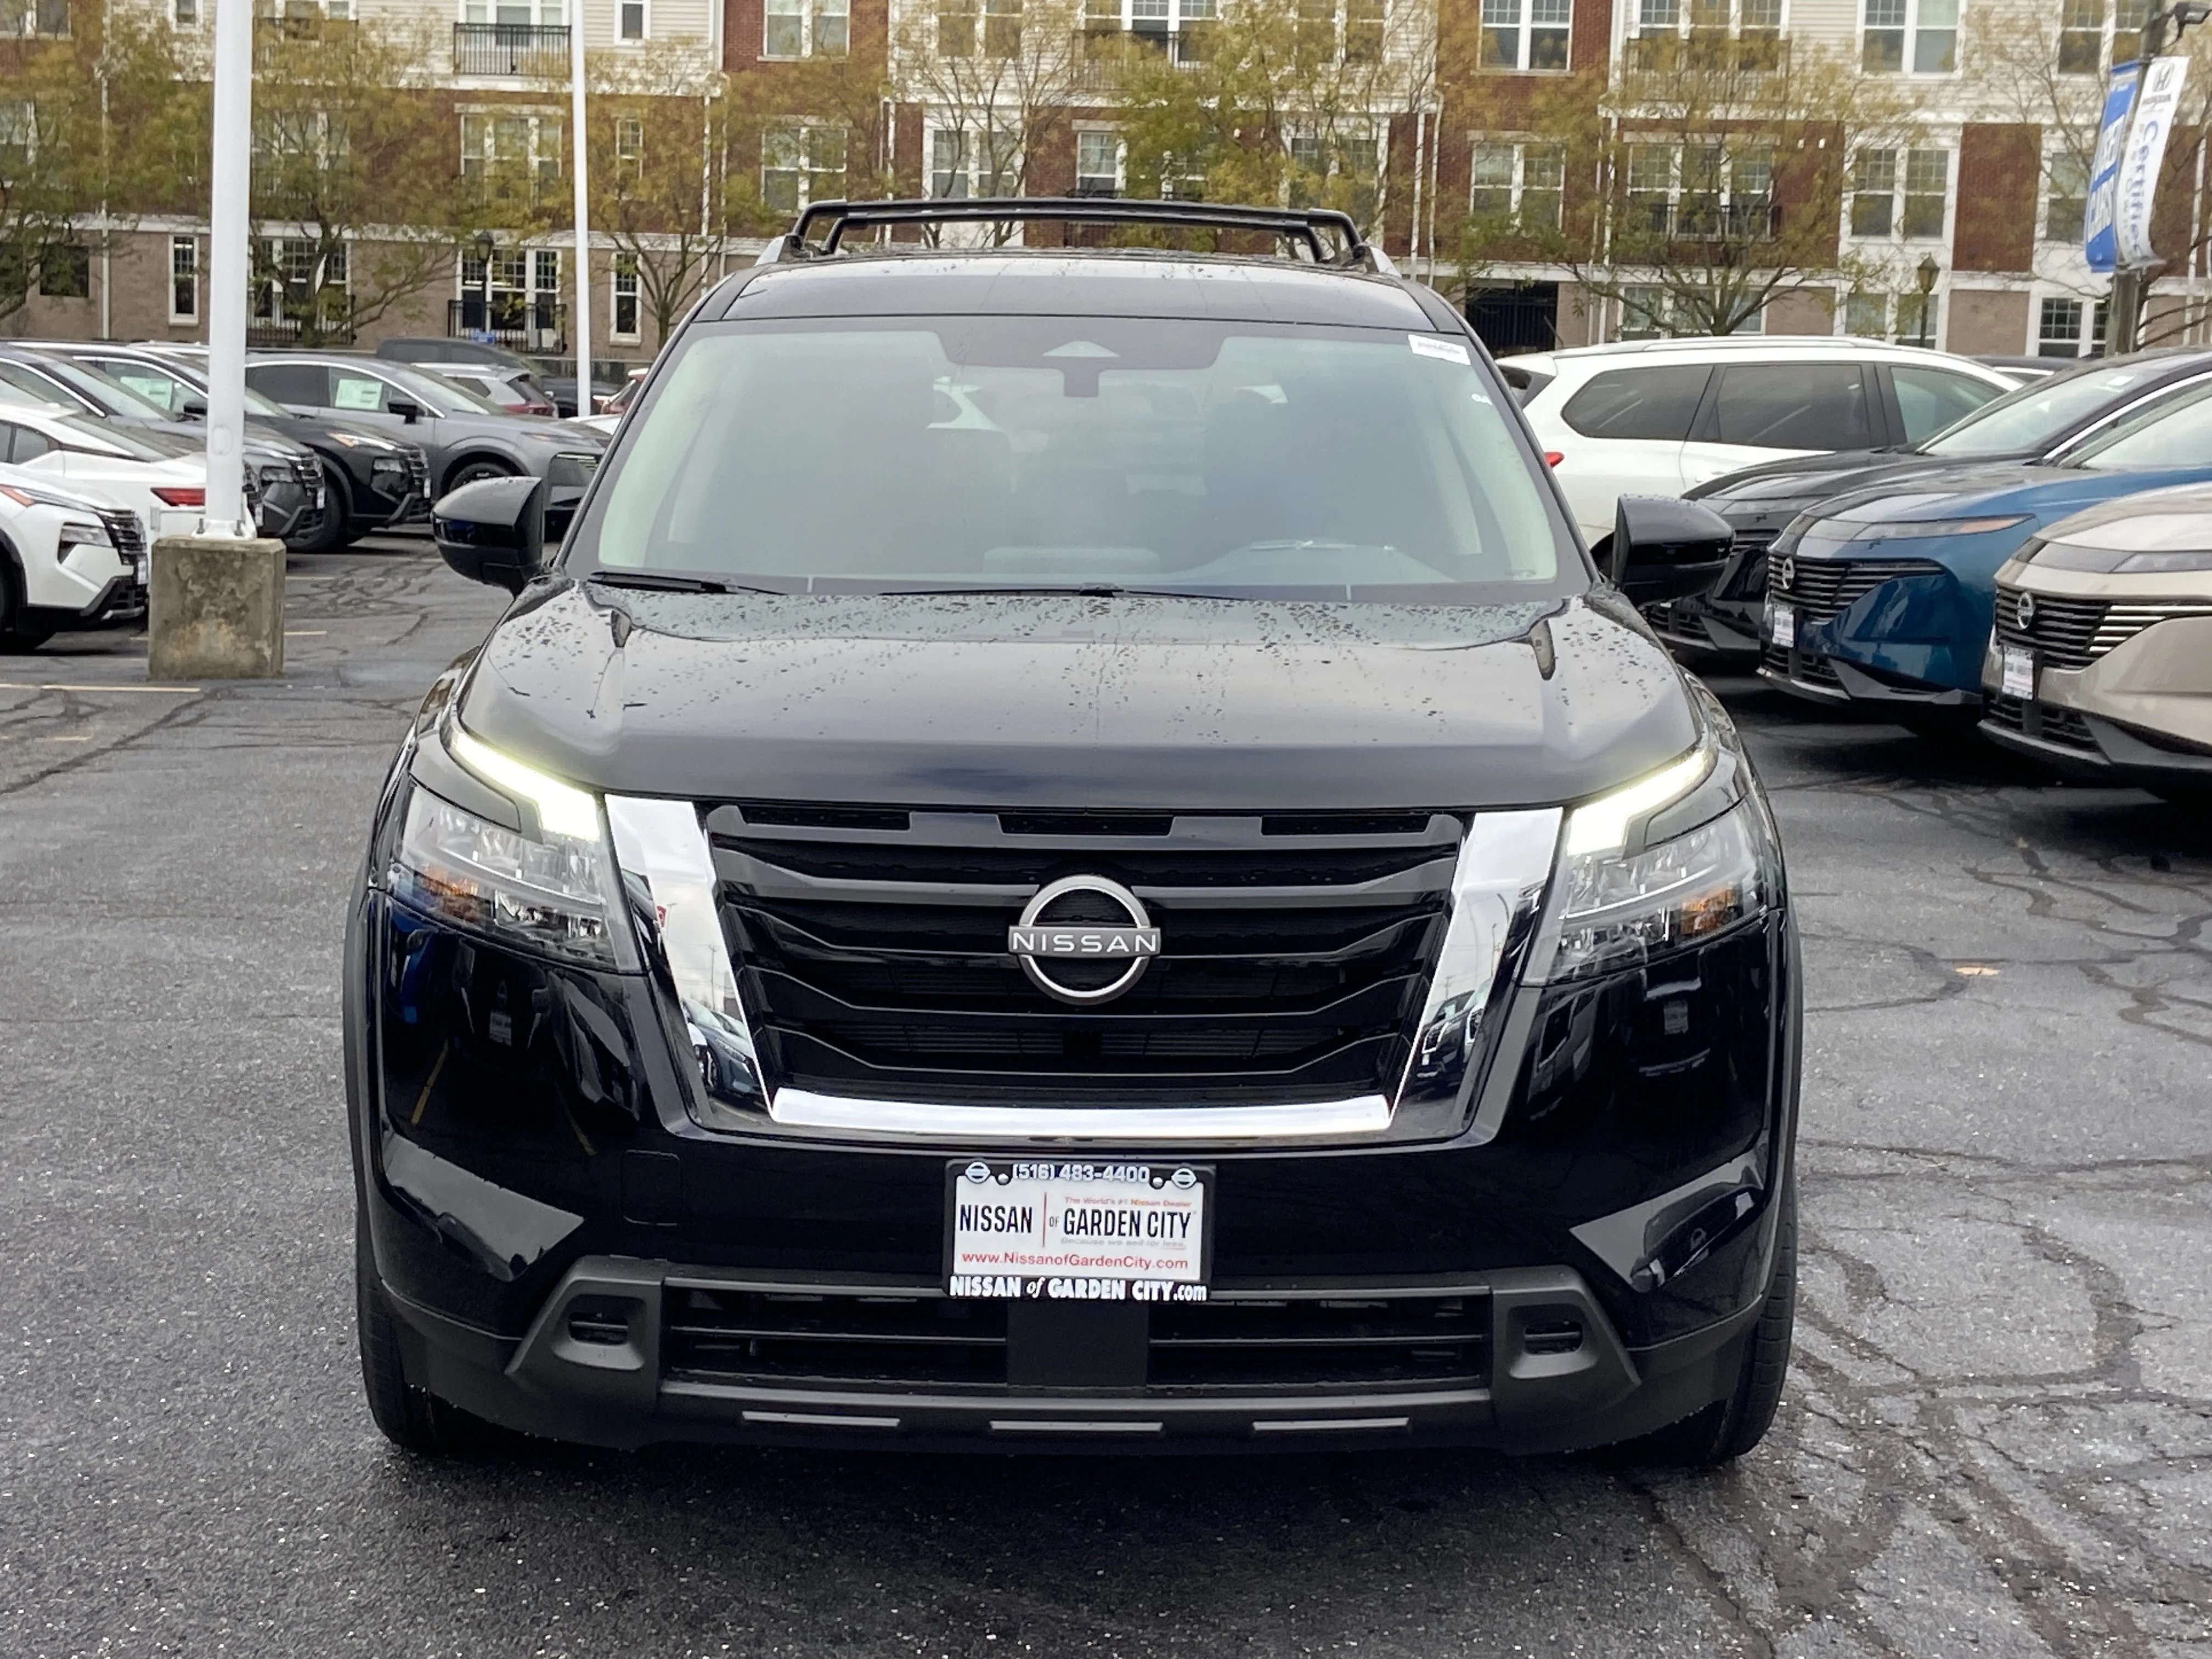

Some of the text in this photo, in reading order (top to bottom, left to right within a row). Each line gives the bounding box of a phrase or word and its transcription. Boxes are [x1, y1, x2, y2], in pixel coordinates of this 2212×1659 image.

[1012, 932, 1156, 952] NISSAN
[1012, 1163, 1150, 1183] (516) 483-4400
[1065, 1196, 1080, 1204] The
[1130, 1198, 1161, 1206] Nissan
[959, 1204, 1191, 1239] NISSAN OF GARDEN CITY
[962, 1251, 1188, 1271] www.NissanofGardenCity.com
[949, 1274, 1207, 1302] NISSAN of GARDEN CITY.com
